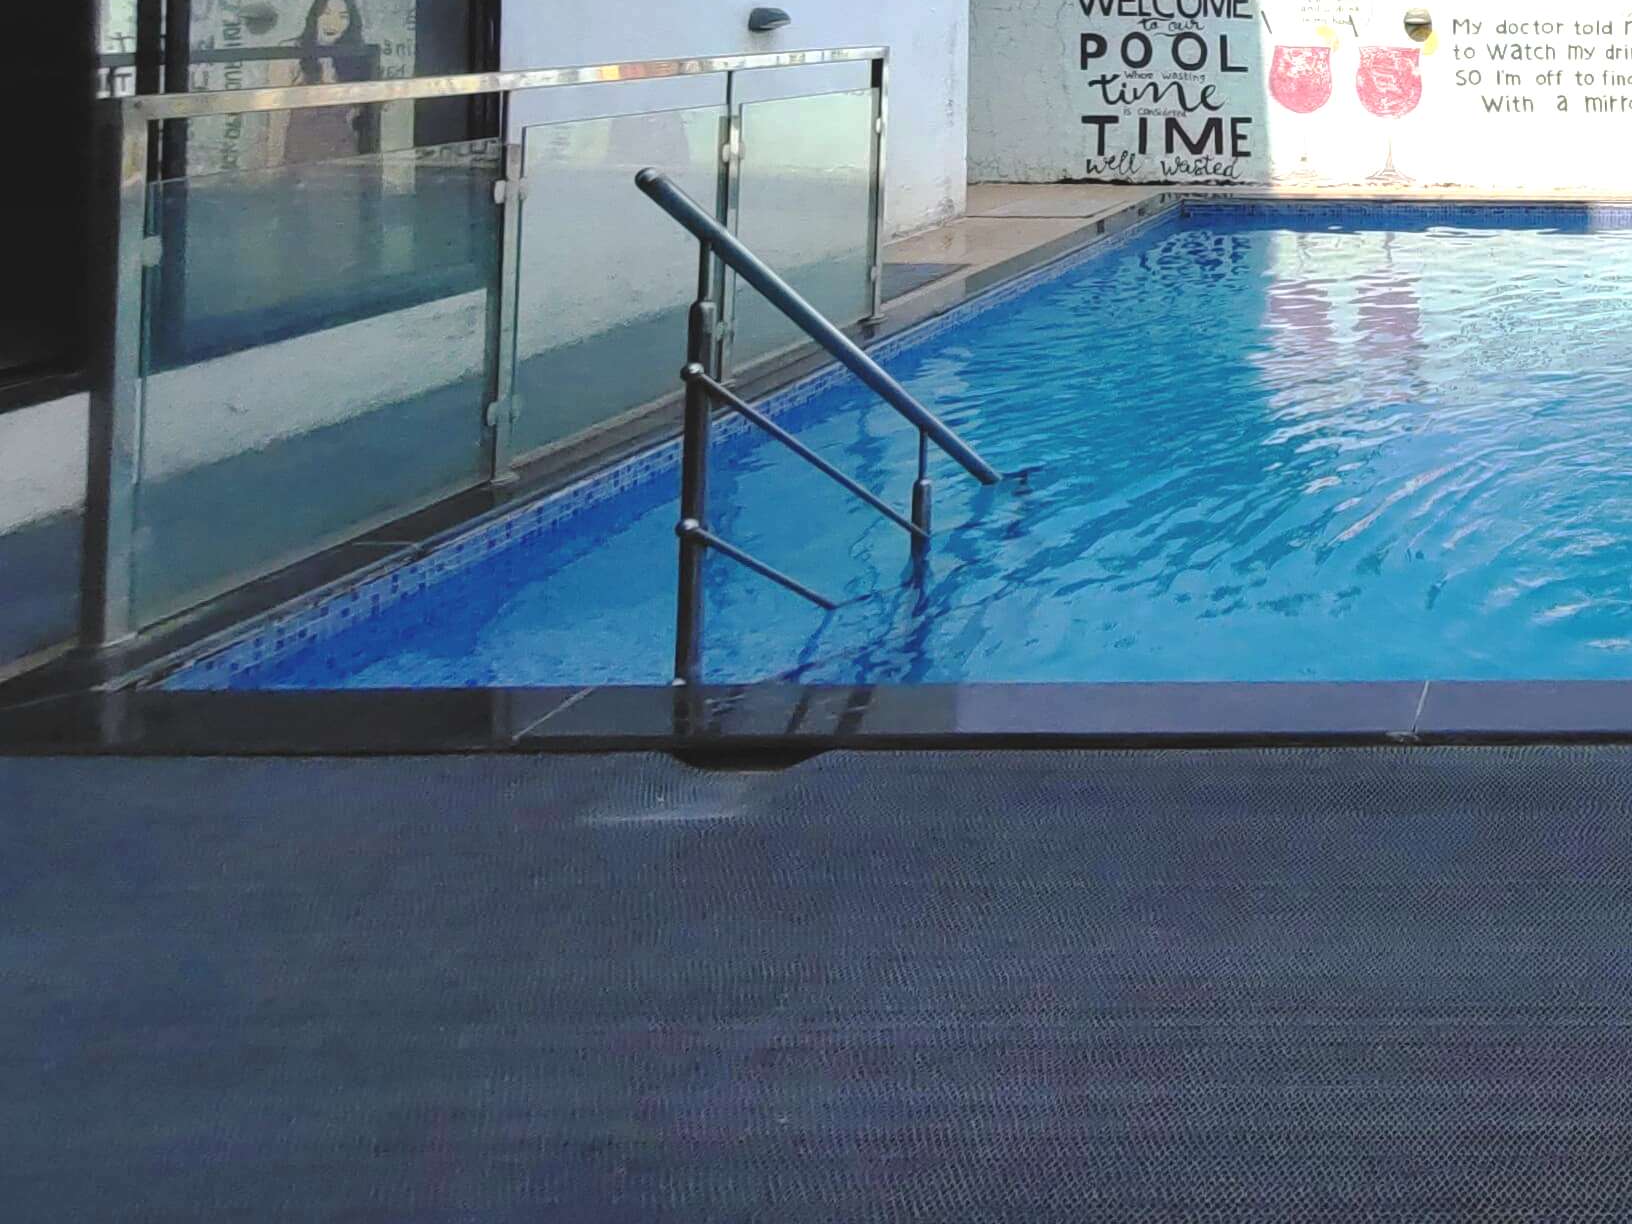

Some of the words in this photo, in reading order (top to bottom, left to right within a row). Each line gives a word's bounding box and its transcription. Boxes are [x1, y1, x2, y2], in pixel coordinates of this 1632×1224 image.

[1168, 18, 1205, 32] our
[1452, 19, 1482, 35] My
[1496, 20, 1564, 35] doctor
[1574, 20, 1613, 35] told
[1080, 31, 1249, 72] POOL
[1453, 44, 1475, 60] to
[1567, 44, 1596, 61] my
[1496, 69, 1521, 85] I'm
[1536, 69, 1564, 86] off
[1575, 70, 1595, 86] to
[1087, 73, 1226, 112] time
[1556, 95, 1568, 112] a
[1081, 115, 1253, 158] TIME
[1086, 150, 1141, 175] well
[1160, 155, 1244, 180] wasted
